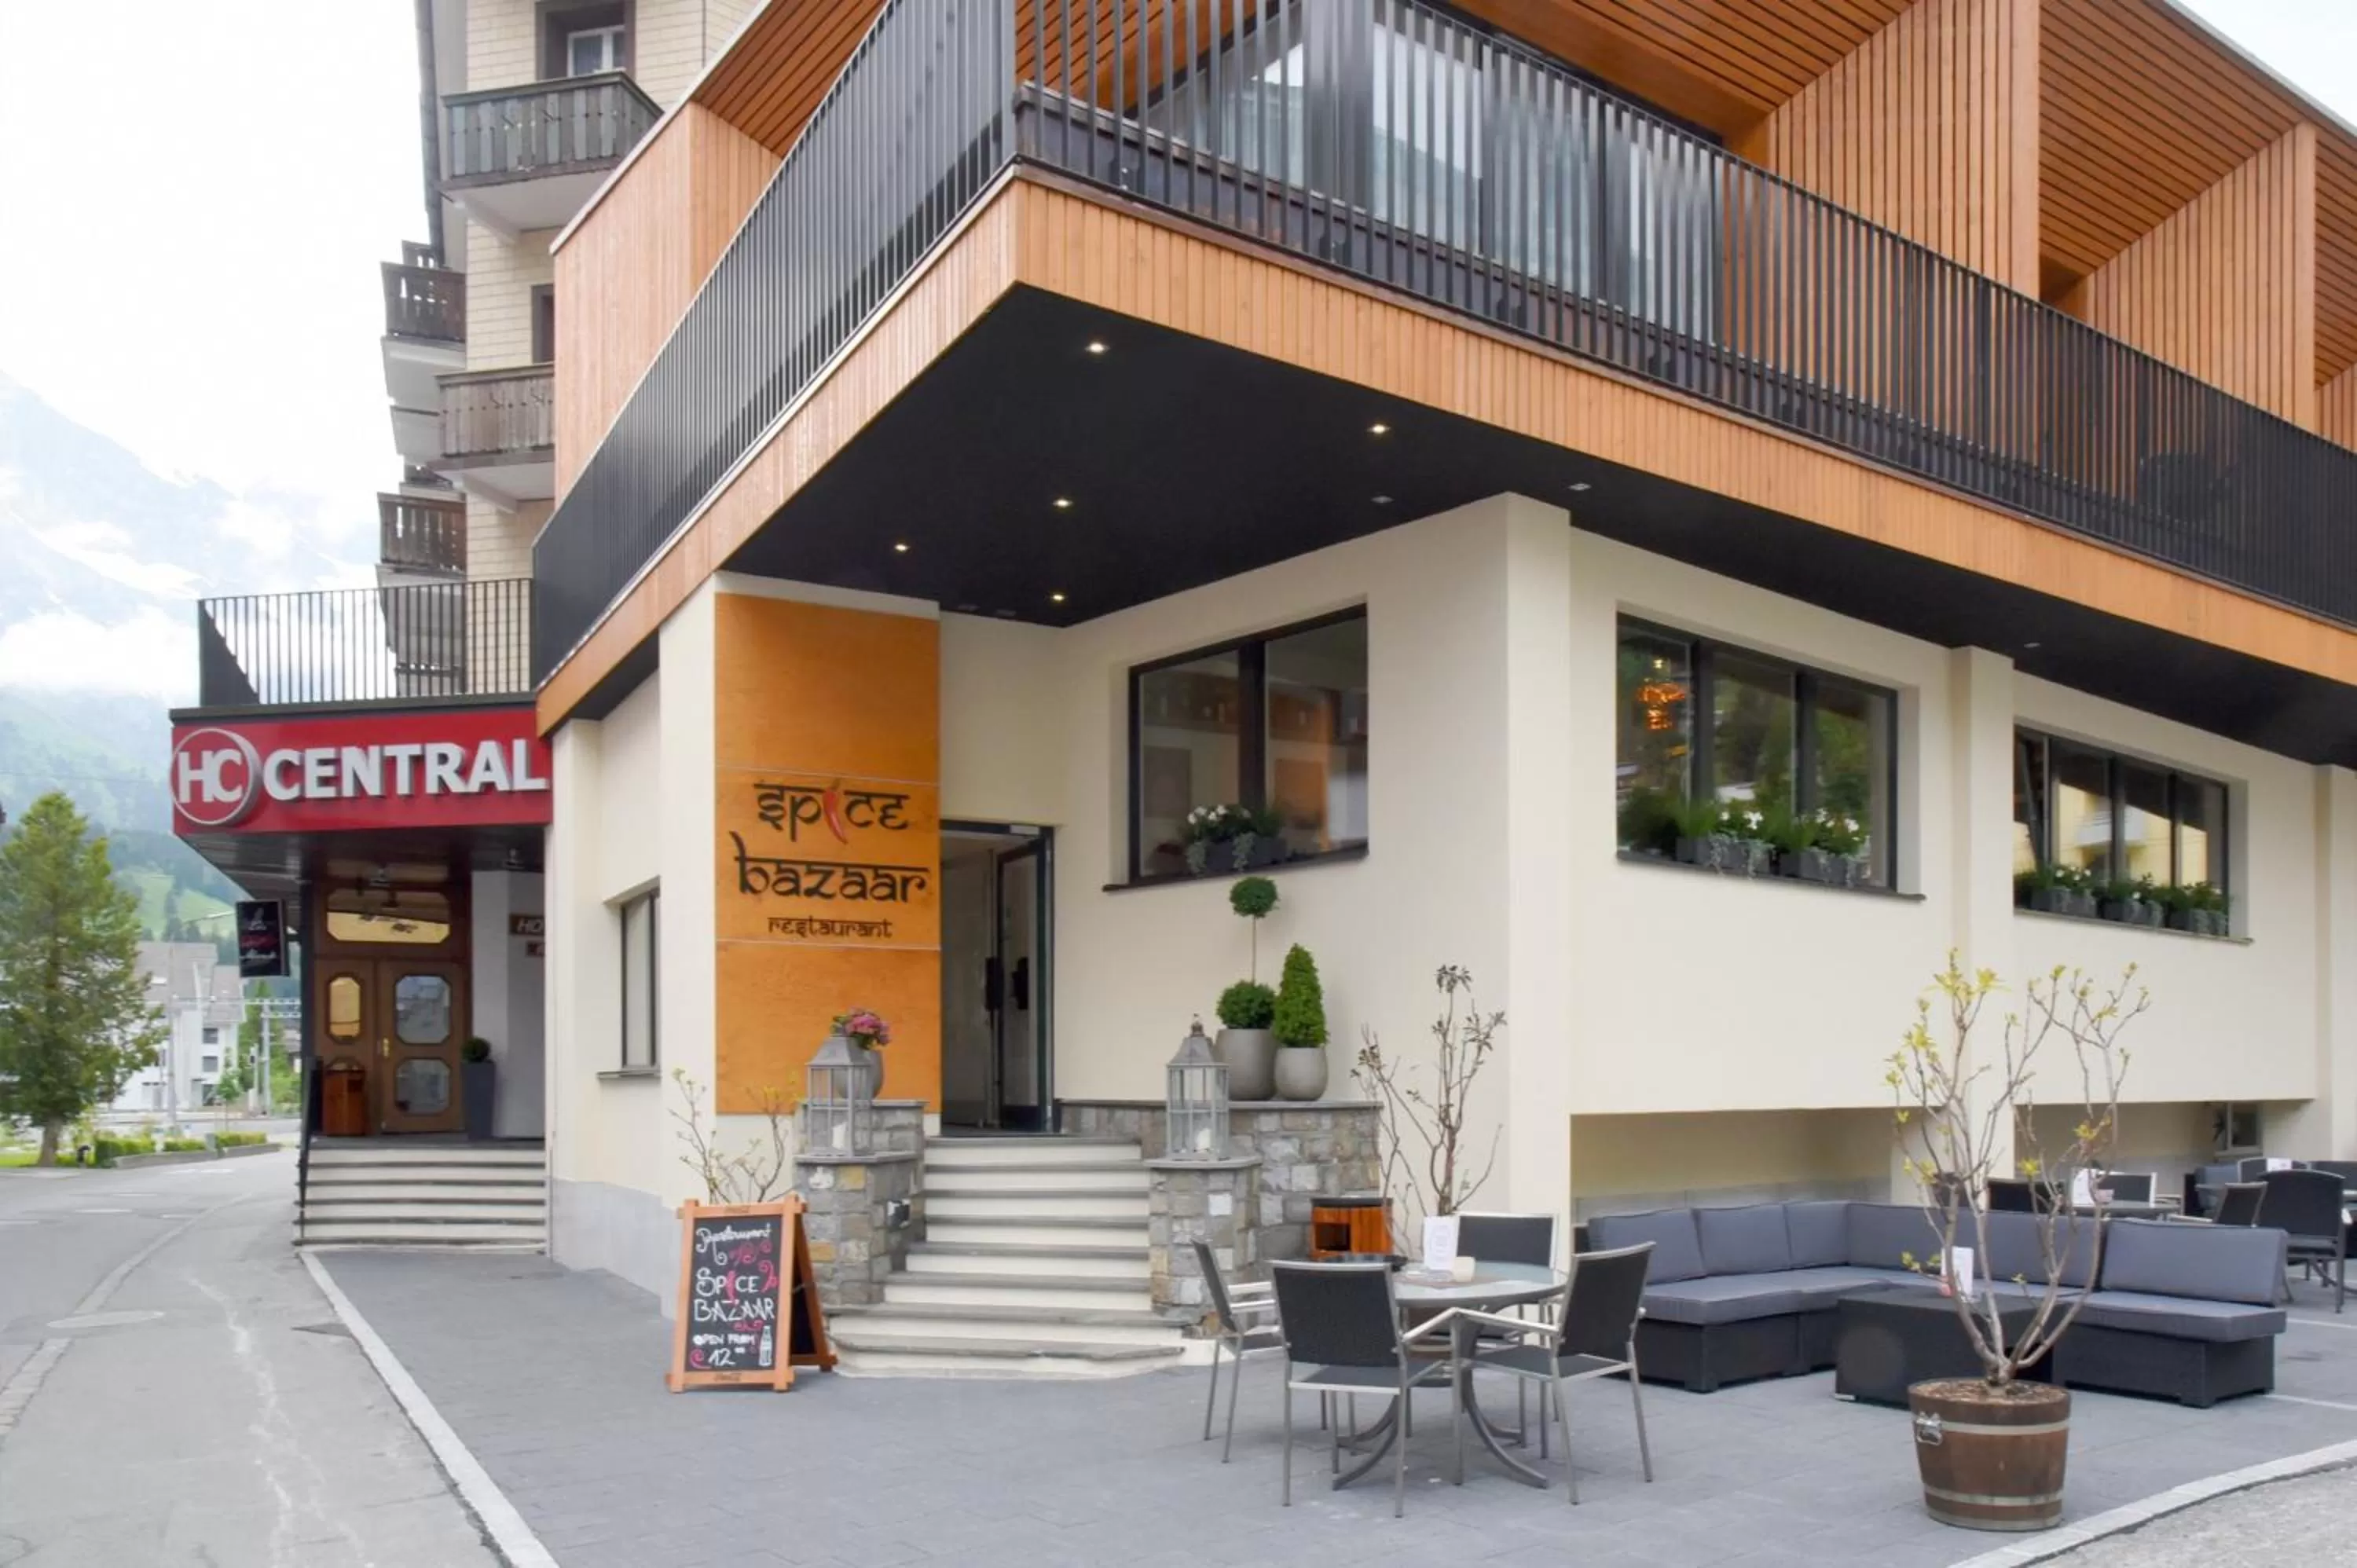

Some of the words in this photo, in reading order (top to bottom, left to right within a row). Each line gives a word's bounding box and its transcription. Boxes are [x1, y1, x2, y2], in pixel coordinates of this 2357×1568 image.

[177, 748, 244, 804] HC
[262, 739, 548, 801] CENTRAL
[729, 830, 930, 903] bazaar
[767, 915, 893, 938] restaurant
[693, 1297, 775, 1322] BAZAAR
